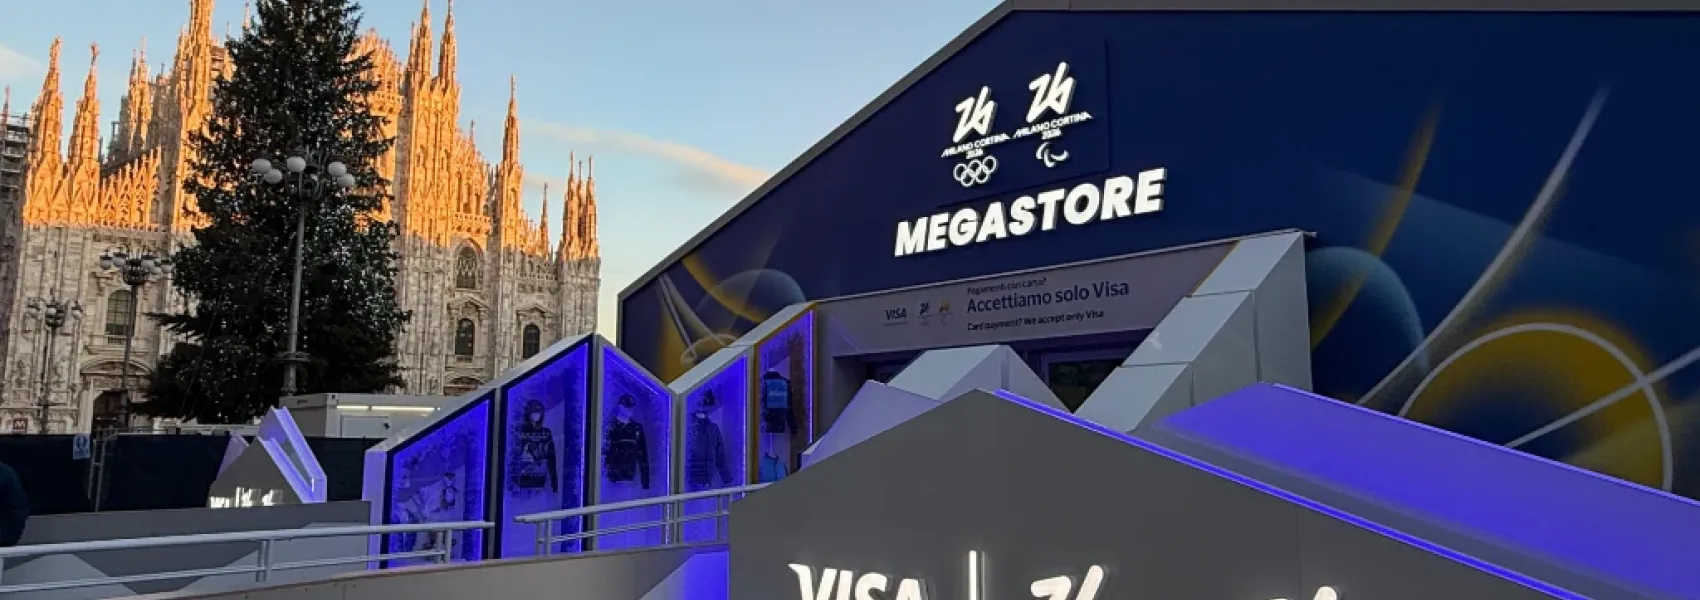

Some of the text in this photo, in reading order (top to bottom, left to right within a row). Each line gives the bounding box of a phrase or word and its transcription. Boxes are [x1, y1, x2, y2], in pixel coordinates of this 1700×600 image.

[1013, 111, 1093, 138] MILANO CORTINA
[941, 133, 1011, 158] MILANO CORTINA
[894, 167, 1167, 257] MEGASTORE
[967, 292, 1052, 314] Accettiamo
[1055, 284, 1090, 304] solo
[1092, 280, 1130, 299] Visa
[884, 307, 907, 321] VISA
[1085, 309, 1104, 319] Visa
